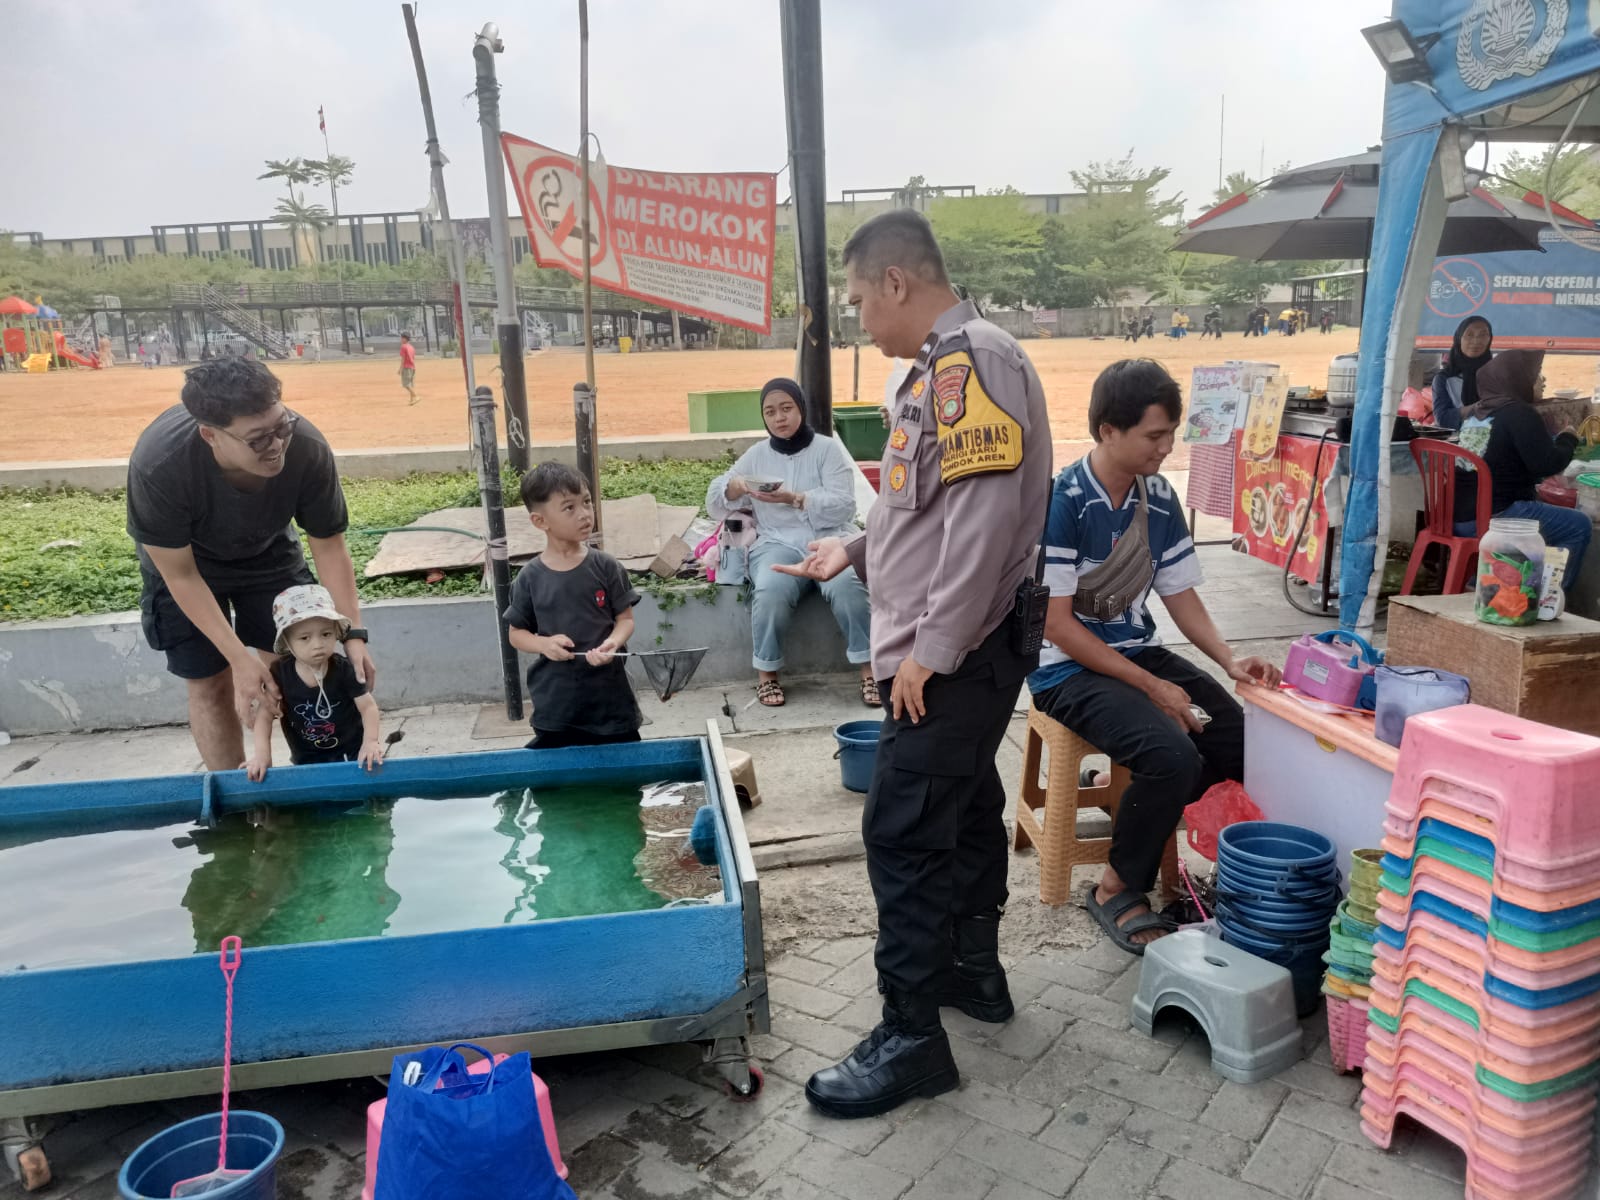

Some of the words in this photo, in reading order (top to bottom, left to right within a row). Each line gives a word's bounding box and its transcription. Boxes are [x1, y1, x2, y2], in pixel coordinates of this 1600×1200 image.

[614, 168, 767, 209] DILARANG
[614, 195, 767, 245] MEROKOK
[616, 229, 637, 253] DI
[644, 236, 767, 278] ALUN-ALUN
[941, 456, 974, 474] PONDOK
[977, 454, 1006, 463] AREN
[970, 445, 997, 456] BARU
